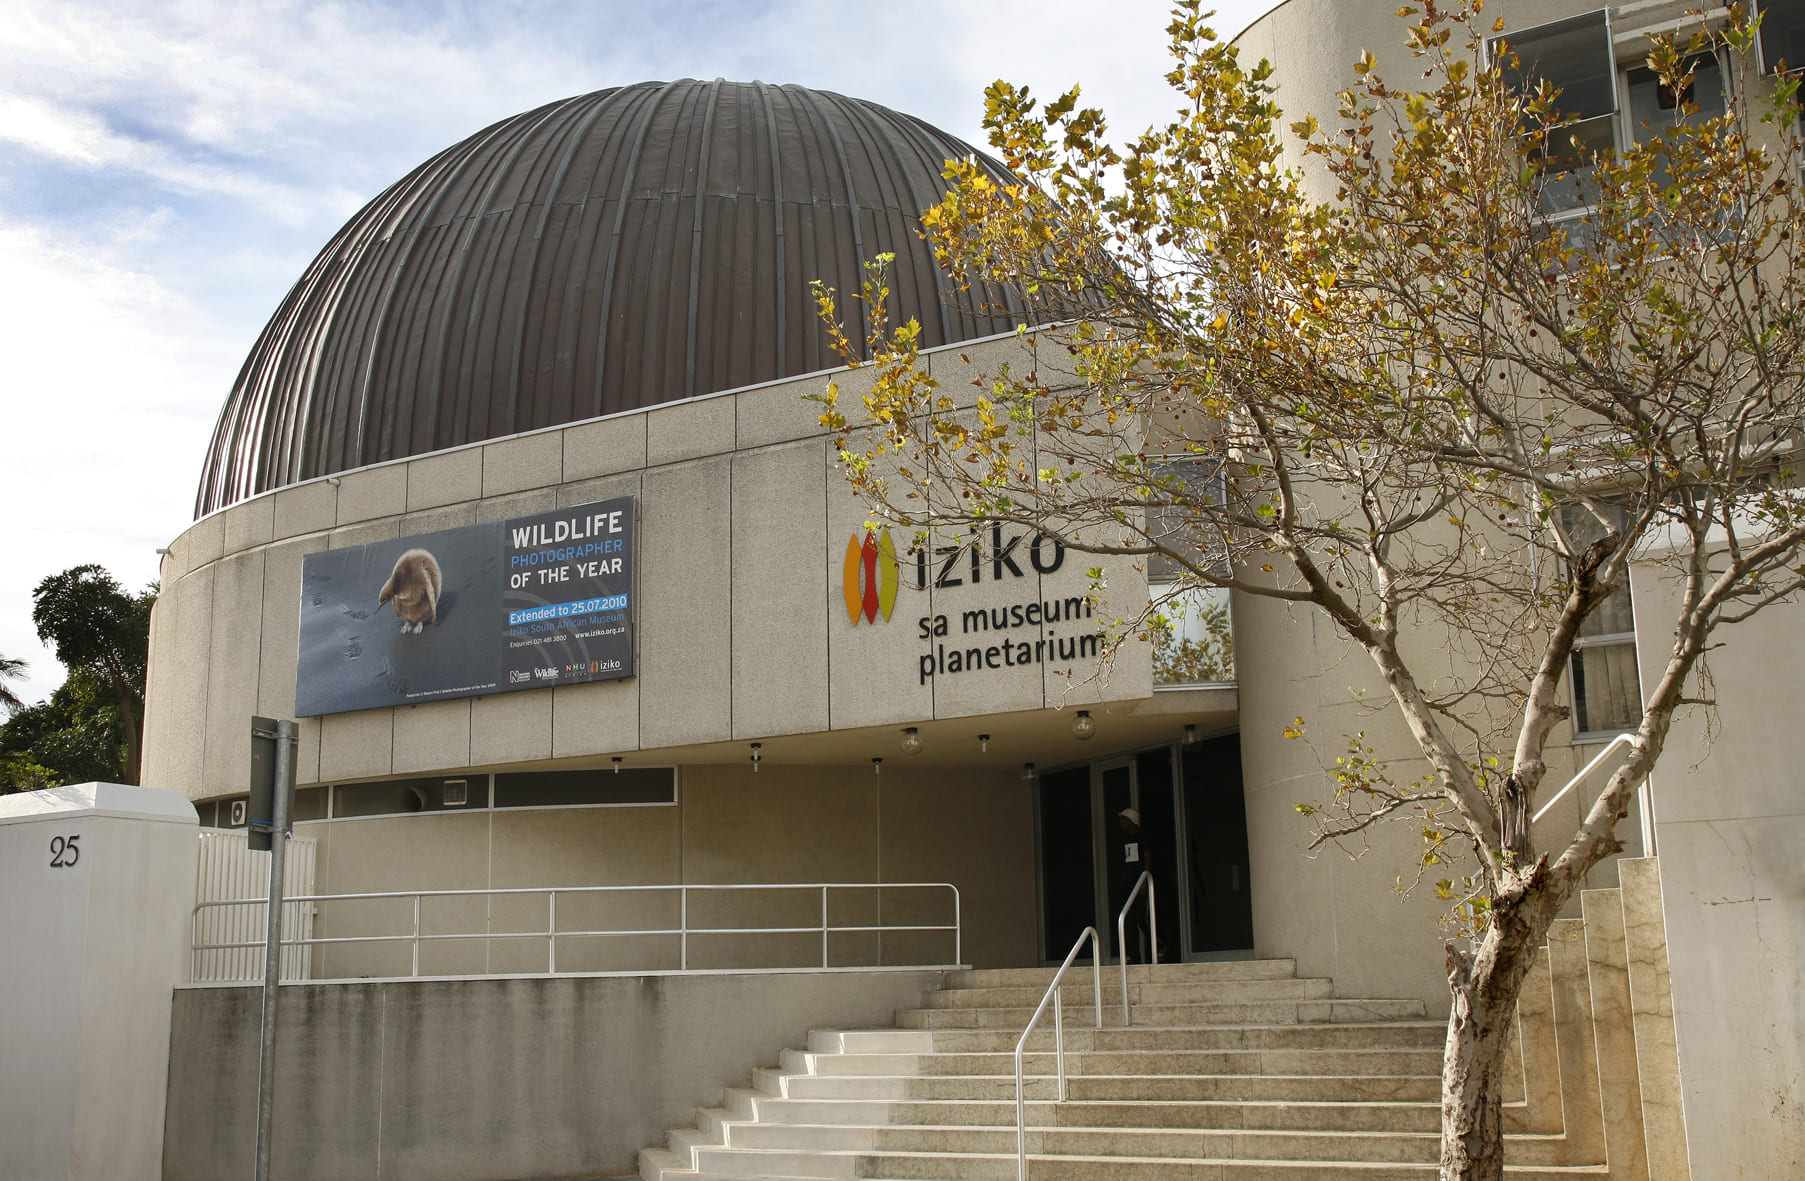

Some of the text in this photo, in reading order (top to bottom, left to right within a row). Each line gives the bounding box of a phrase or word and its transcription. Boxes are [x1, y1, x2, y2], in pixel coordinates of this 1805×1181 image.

[512, 511, 622, 549] WILDLIFE
[511, 539, 623, 568] PHOTOGRAPHER
[917, 522, 1065, 590] iziko
[510, 558, 622, 589] OF THE YEAR
[510, 596, 627, 624] Extended to 25.07.2010
[530, 623, 555, 634] South
[557, 618, 587, 629] African
[589, 613, 625, 625] Museum
[919, 596, 1092, 639] sa museum
[510, 639, 533, 648] Enquiries
[574, 626, 625, 639] www.iziko.org.za
[600, 659, 620, 670] iziko
[920, 631, 1106, 685] planetarium
[50, 834, 80, 868] 25
